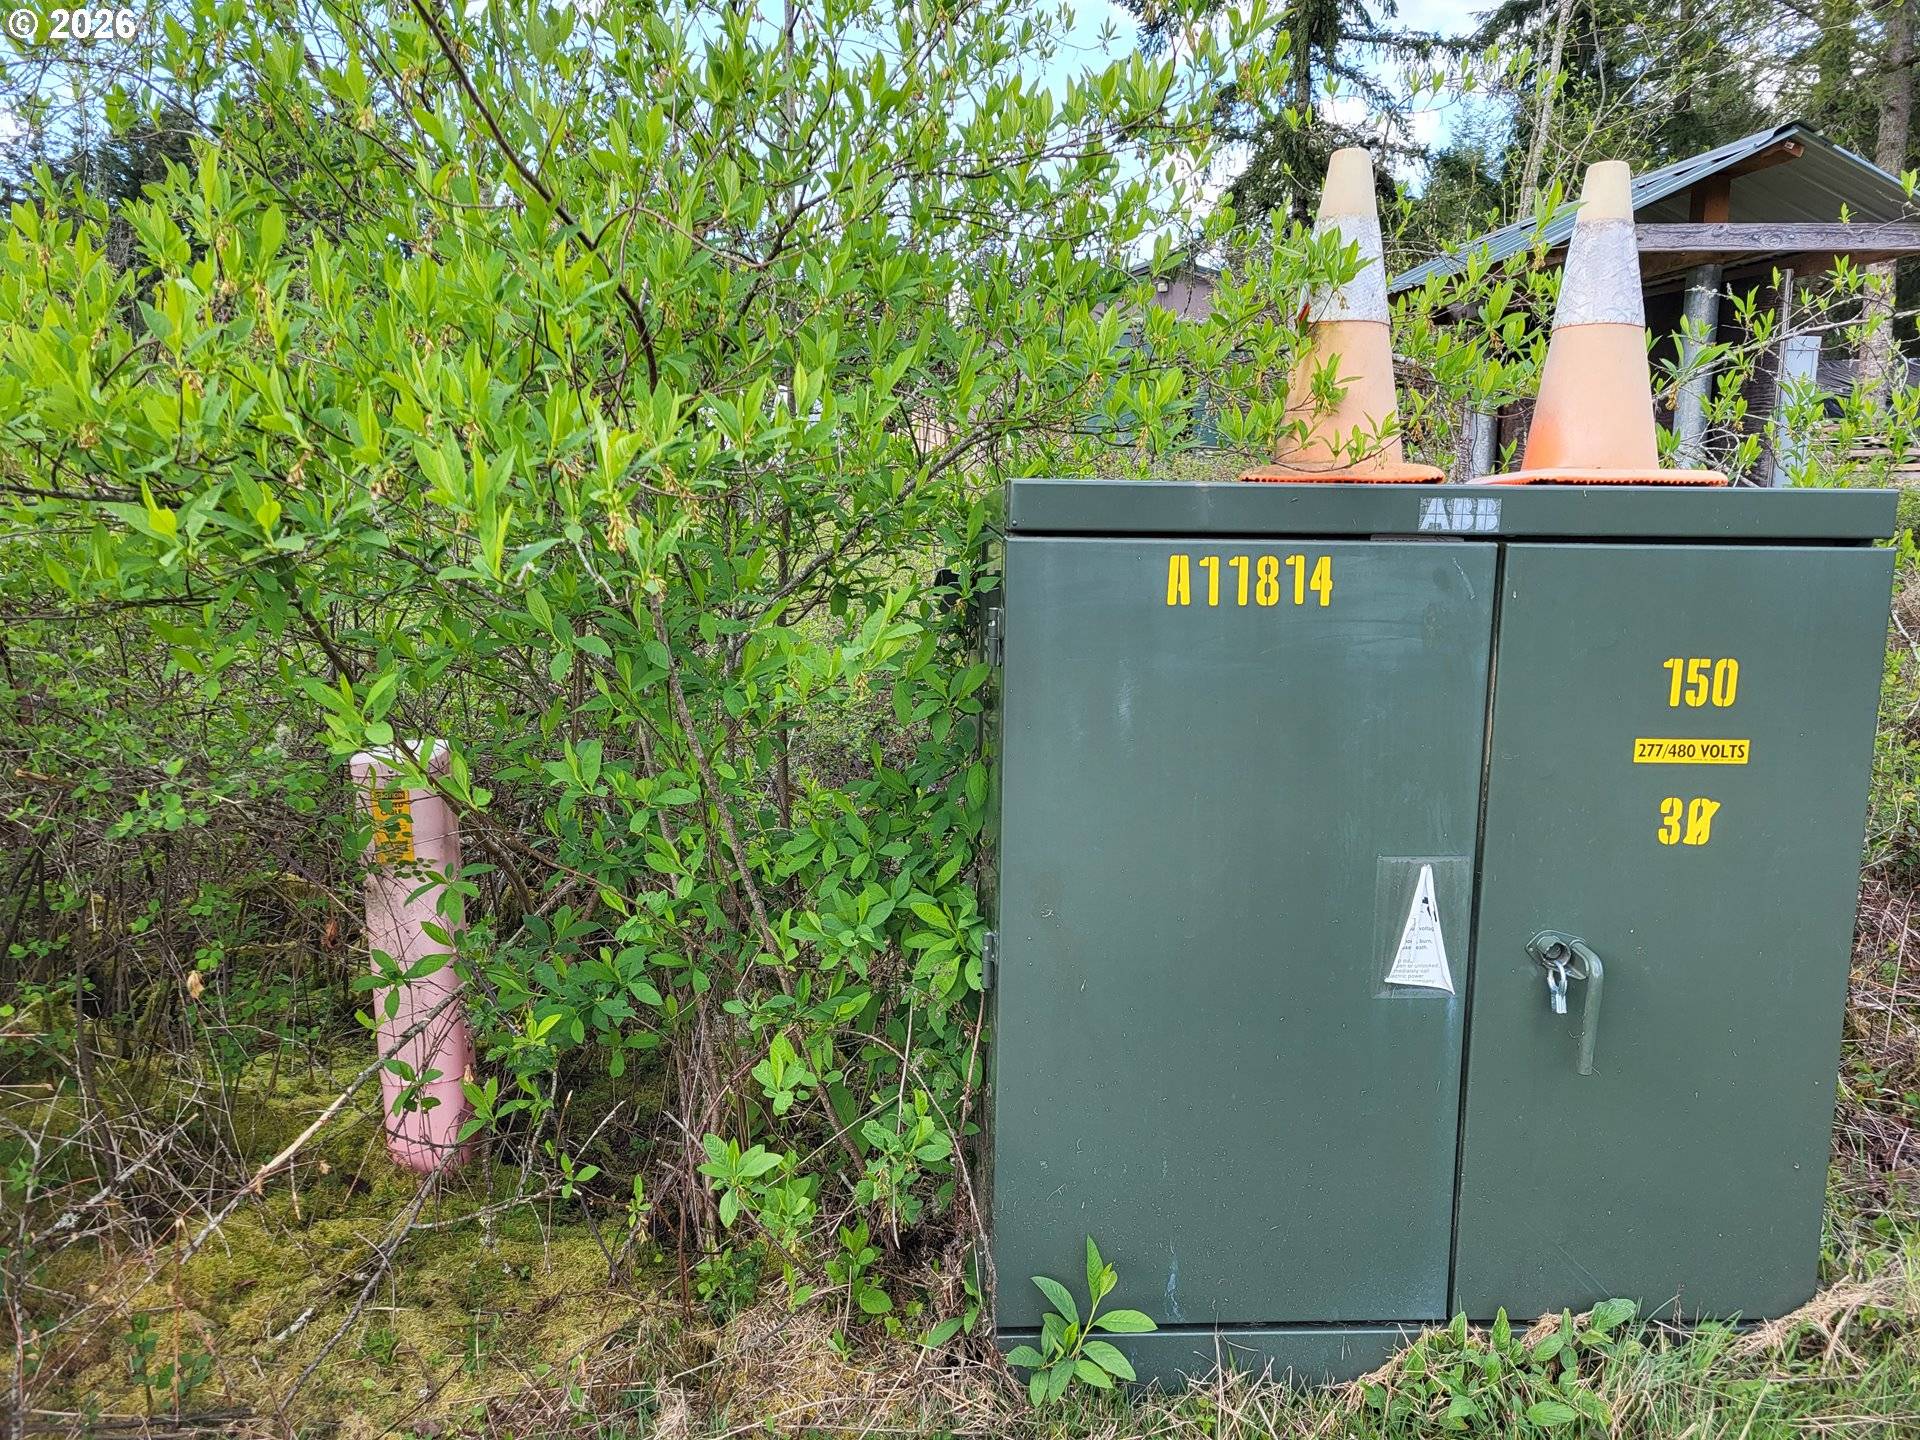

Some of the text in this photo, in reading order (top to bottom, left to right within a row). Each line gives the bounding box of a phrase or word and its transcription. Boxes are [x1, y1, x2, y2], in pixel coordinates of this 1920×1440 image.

[1420, 497, 1499, 531] ABB
[1167, 555, 1333, 606] A11814
[1663, 658, 1738, 707] 150
[1639, 743, 1745, 759] 277/480 VOLTS
